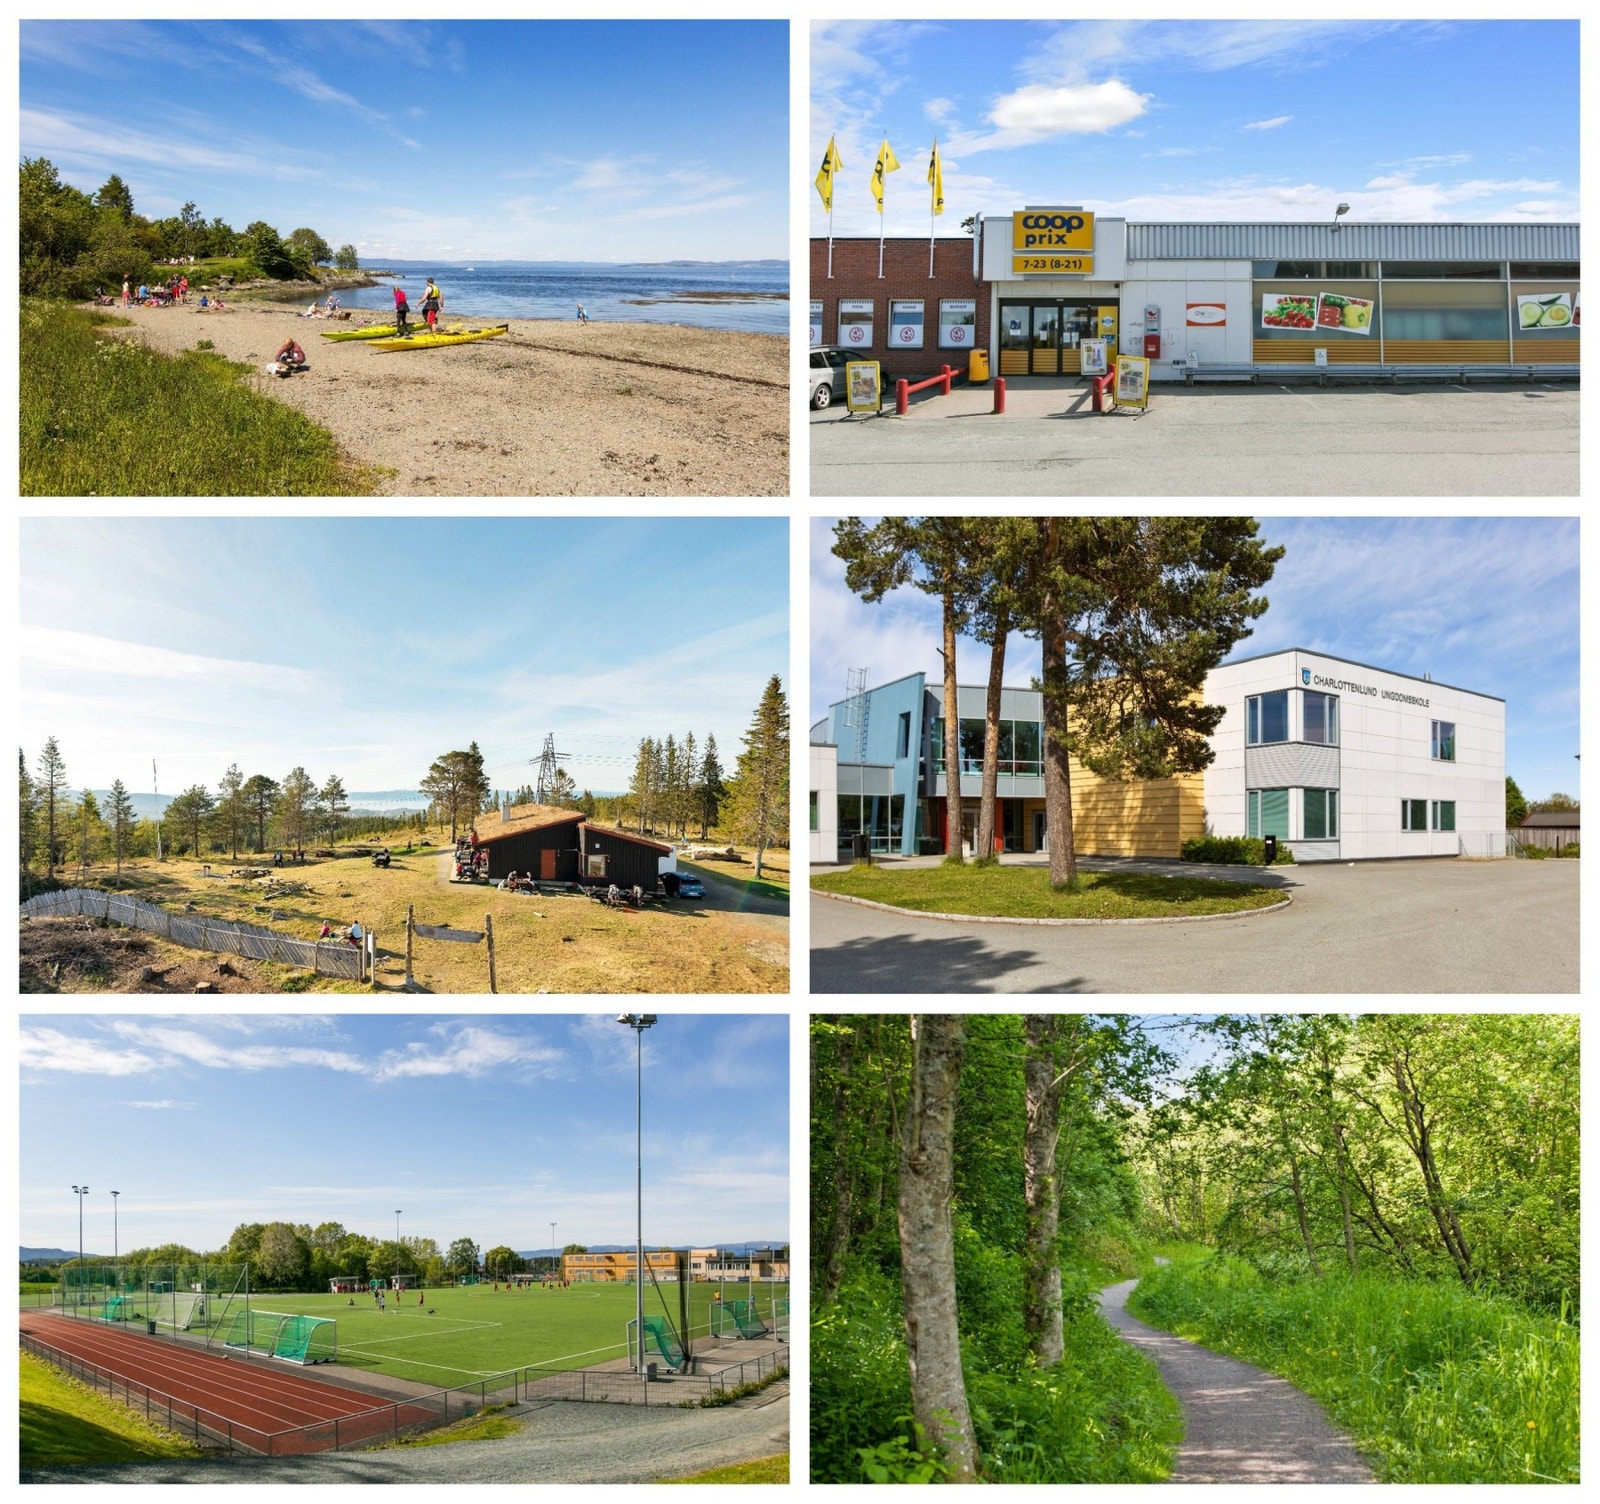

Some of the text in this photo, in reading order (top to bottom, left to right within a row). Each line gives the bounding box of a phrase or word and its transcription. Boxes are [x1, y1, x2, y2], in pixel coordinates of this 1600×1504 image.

[1022, 215, 1084, 233] coop
[1025, 228, 1067, 247] prix
[1023, 258, 1082, 269] 7-23 (8-21)
[1313, 674, 1430, 708] CHARLOTTENLUND UNGDOMSSKOLE
